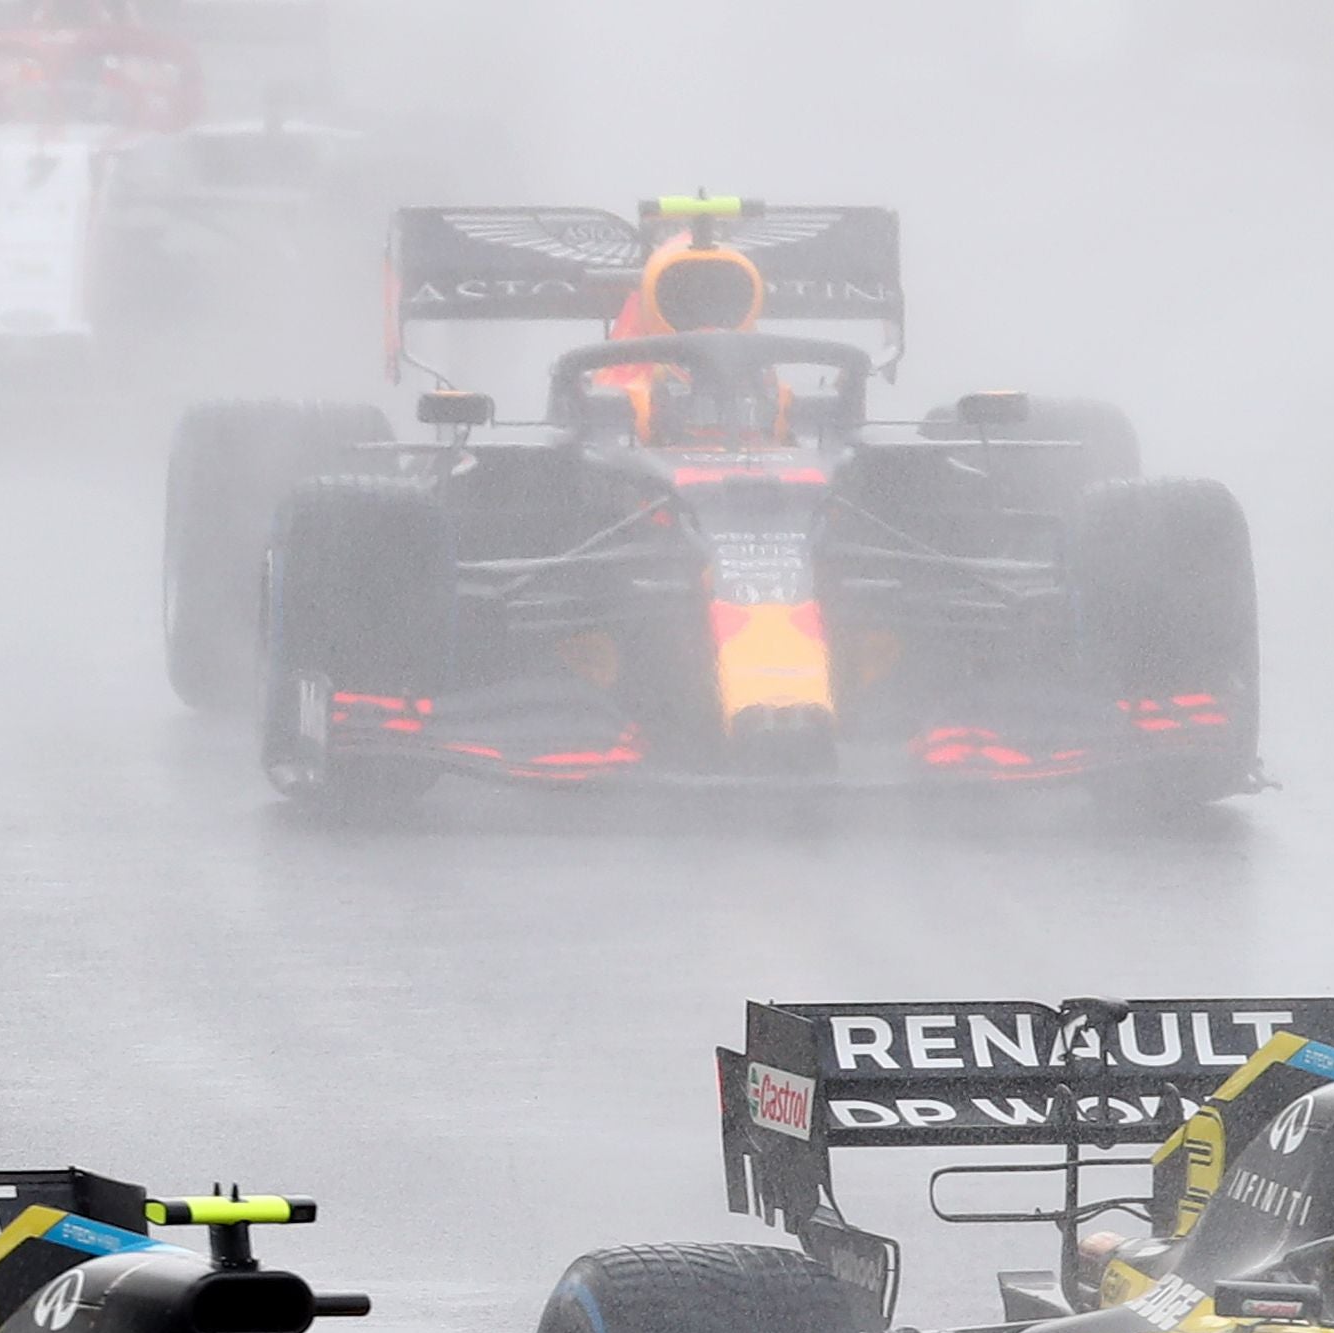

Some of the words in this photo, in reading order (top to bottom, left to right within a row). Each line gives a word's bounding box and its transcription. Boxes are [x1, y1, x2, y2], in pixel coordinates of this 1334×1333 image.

[830, 1011, 1294, 1070] RENAULT
[761, 1073, 810, 1131] Castrol
[1228, 1168, 1313, 1227] INFINITI
